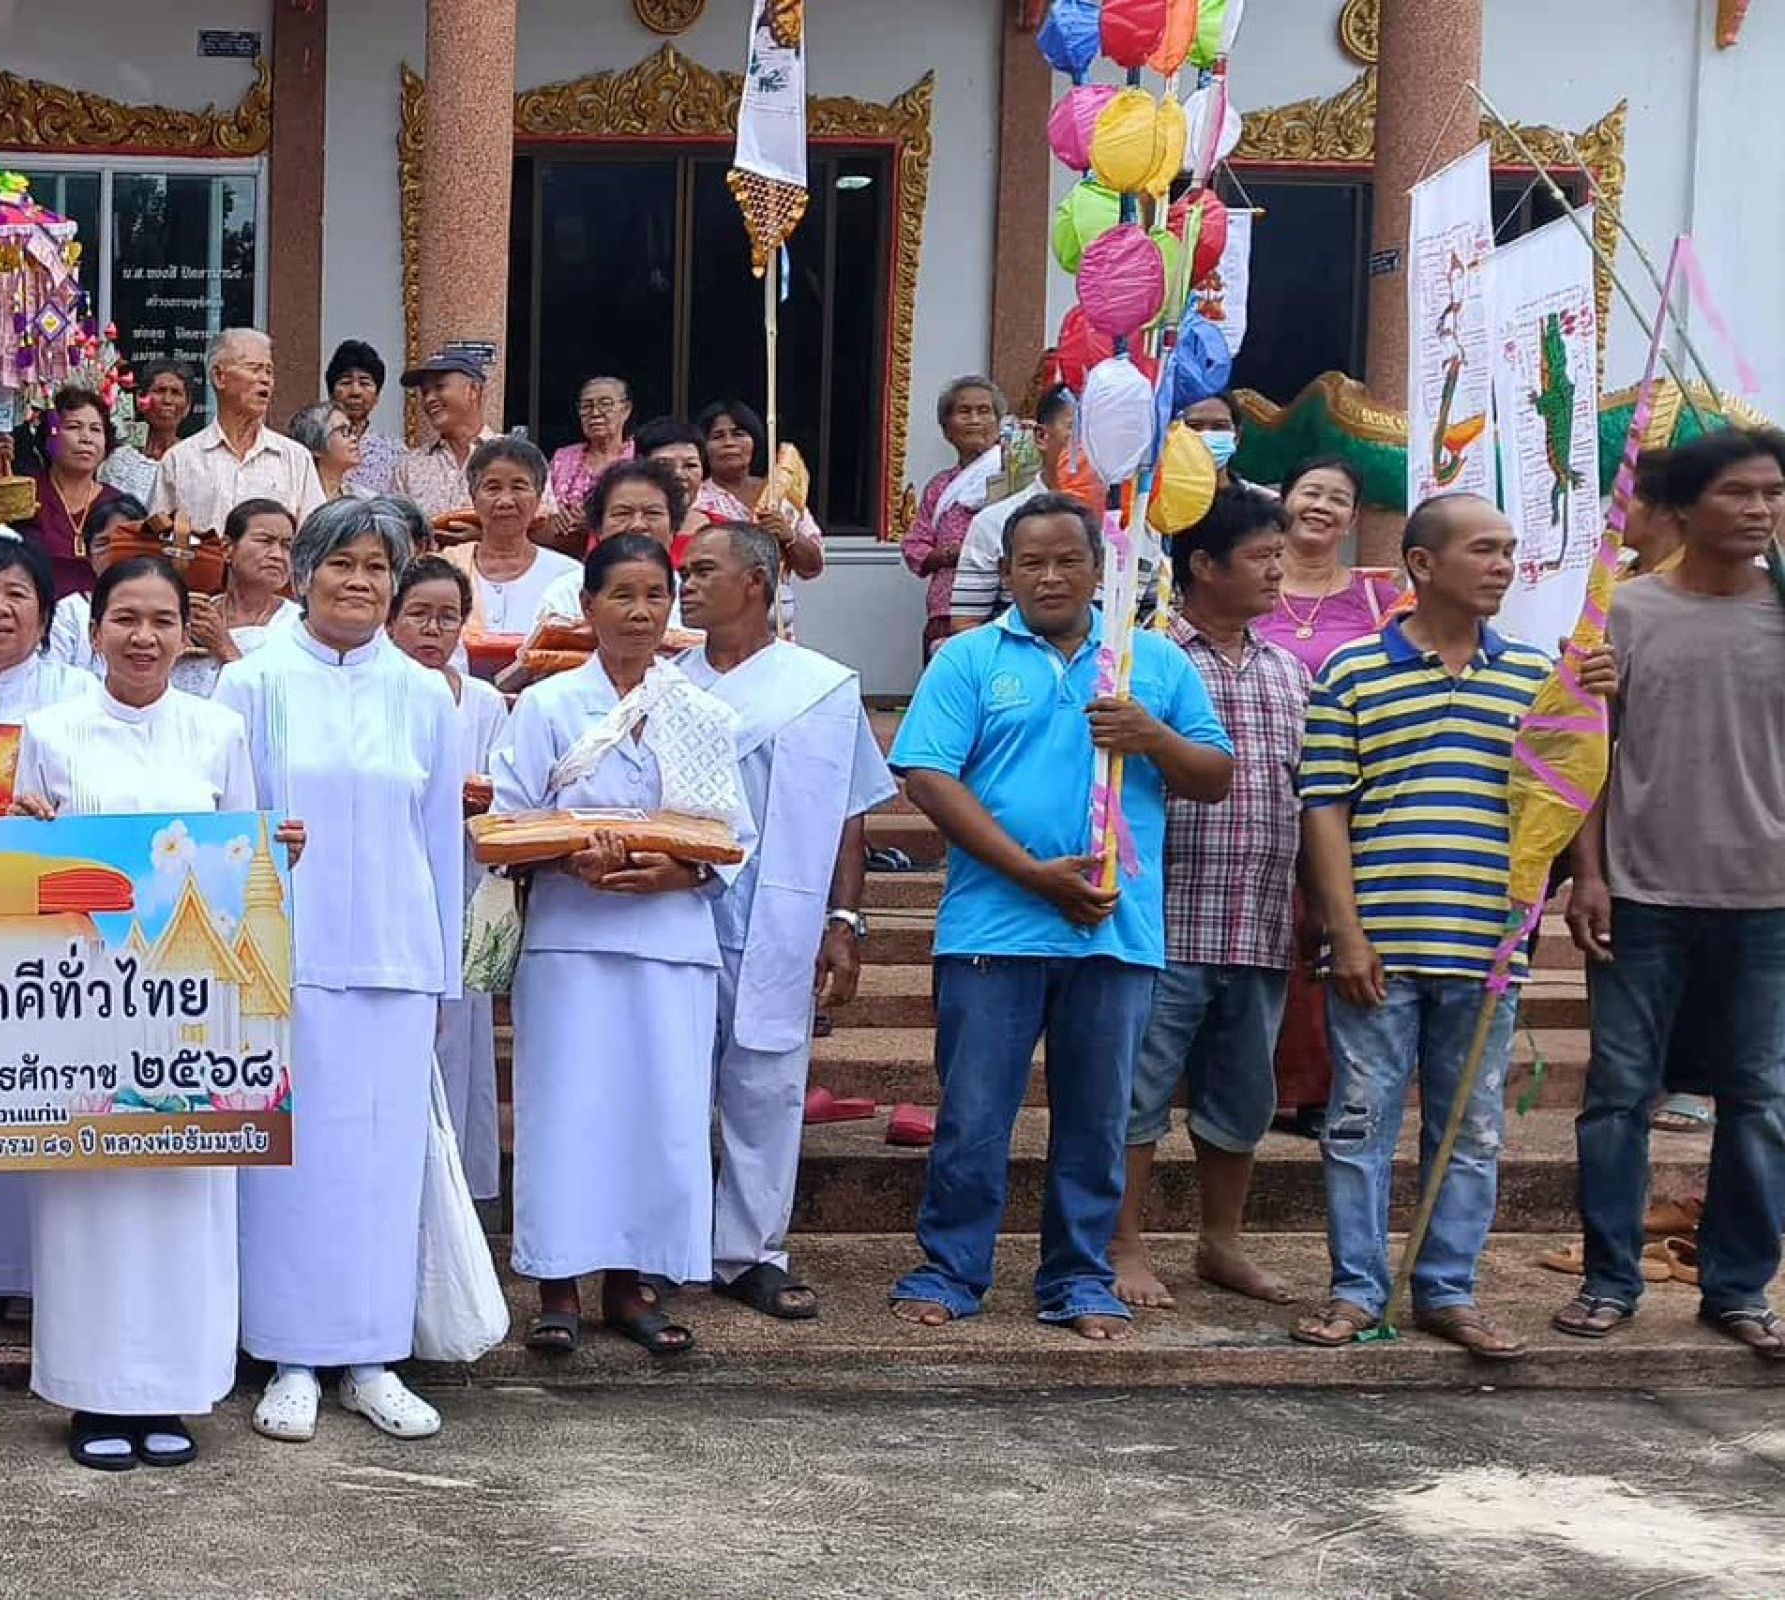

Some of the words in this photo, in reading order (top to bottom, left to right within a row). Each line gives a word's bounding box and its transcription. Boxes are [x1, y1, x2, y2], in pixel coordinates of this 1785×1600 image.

[130, 1048, 274, 1089] ๒๕๖๘
[43, 1138, 73, 1154] ๘๑
[79, 1129, 95, 1153] ปี
[102, 1126, 269, 1153] หลวงพ่อธัมมชโย
